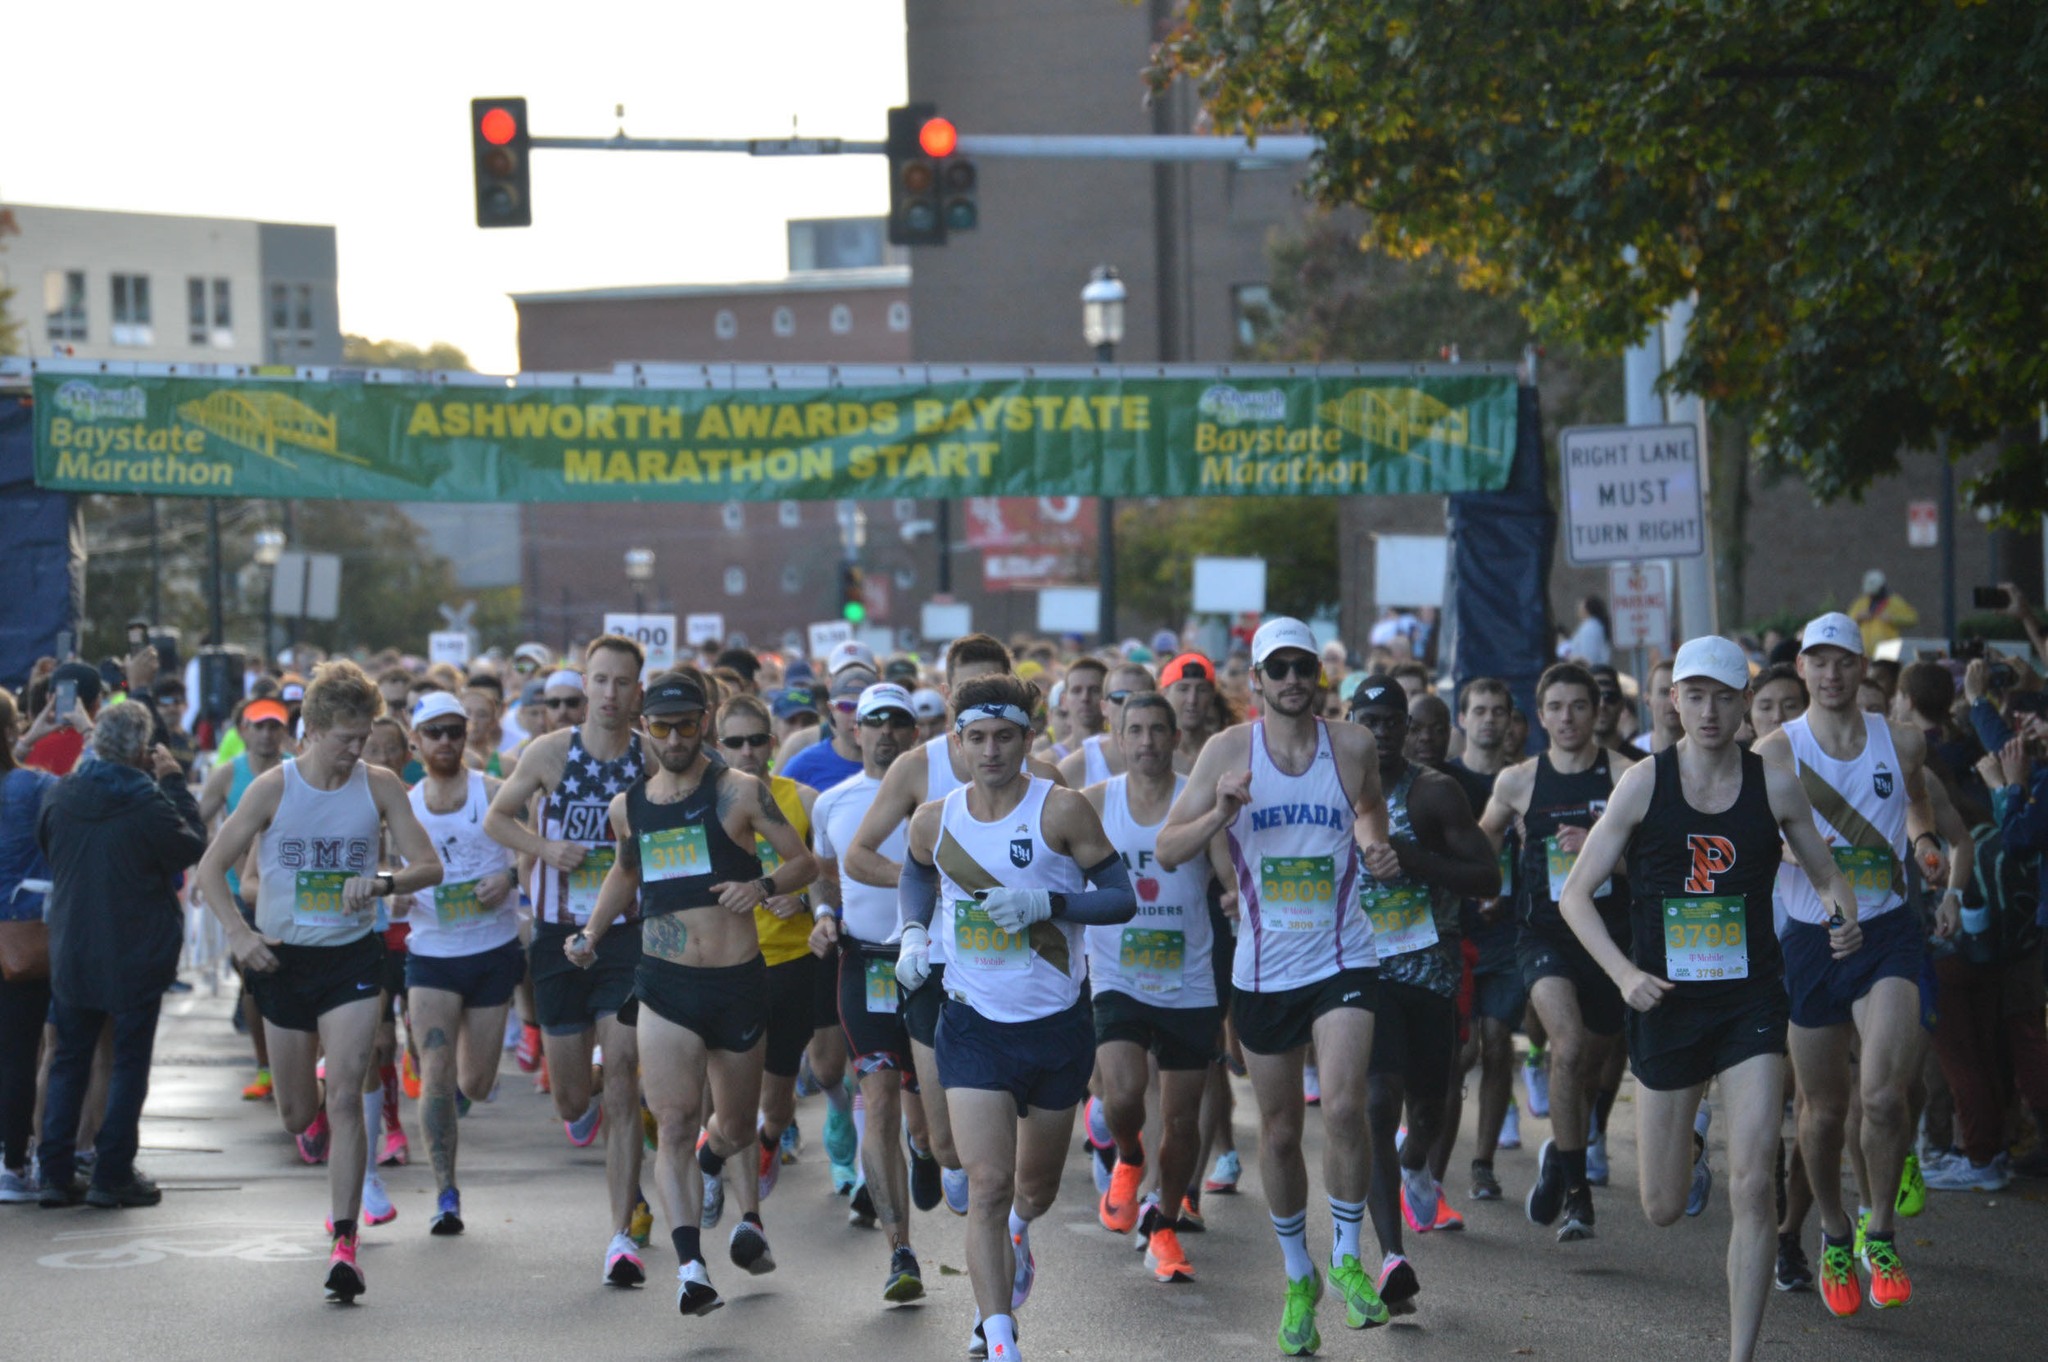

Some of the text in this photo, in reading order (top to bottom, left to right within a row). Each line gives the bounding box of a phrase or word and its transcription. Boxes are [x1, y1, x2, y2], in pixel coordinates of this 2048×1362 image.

[407, 395, 1150, 440] ASHWORTH AWARDS BAYSTATE
[51, 417, 206, 457] Baystate
[1195, 422, 1344, 459] Baystate
[55, 449, 234, 487] Marathon
[564, 442, 1000, 484] MARATHON START
[1571, 440, 1693, 468] RIGHT LANE
[1202, 453, 1369, 486] Marathon
[1599, 479, 1669, 507] MUST
[1576, 519, 1697, 546] TURN RIGHT
[1251, 804, 1344, 832] NEVADA
[279, 837, 368, 871] SMS
[652, 844, 697, 869] 3111
[1685, 834, 1736, 893] P
[1264, 881, 1332, 903] 3809
[1846, 868, 1889, 890] 146
[300, 891, 341, 912] 381
[1371, 906, 1426, 934] 3813
[959, 926, 1022, 951] 3601
[1669, 922, 1742, 948] 3798
[1121, 947, 1180, 970] 3455
[1696, 968, 1724, 978] 3798
[871, 978, 896, 998] 31
